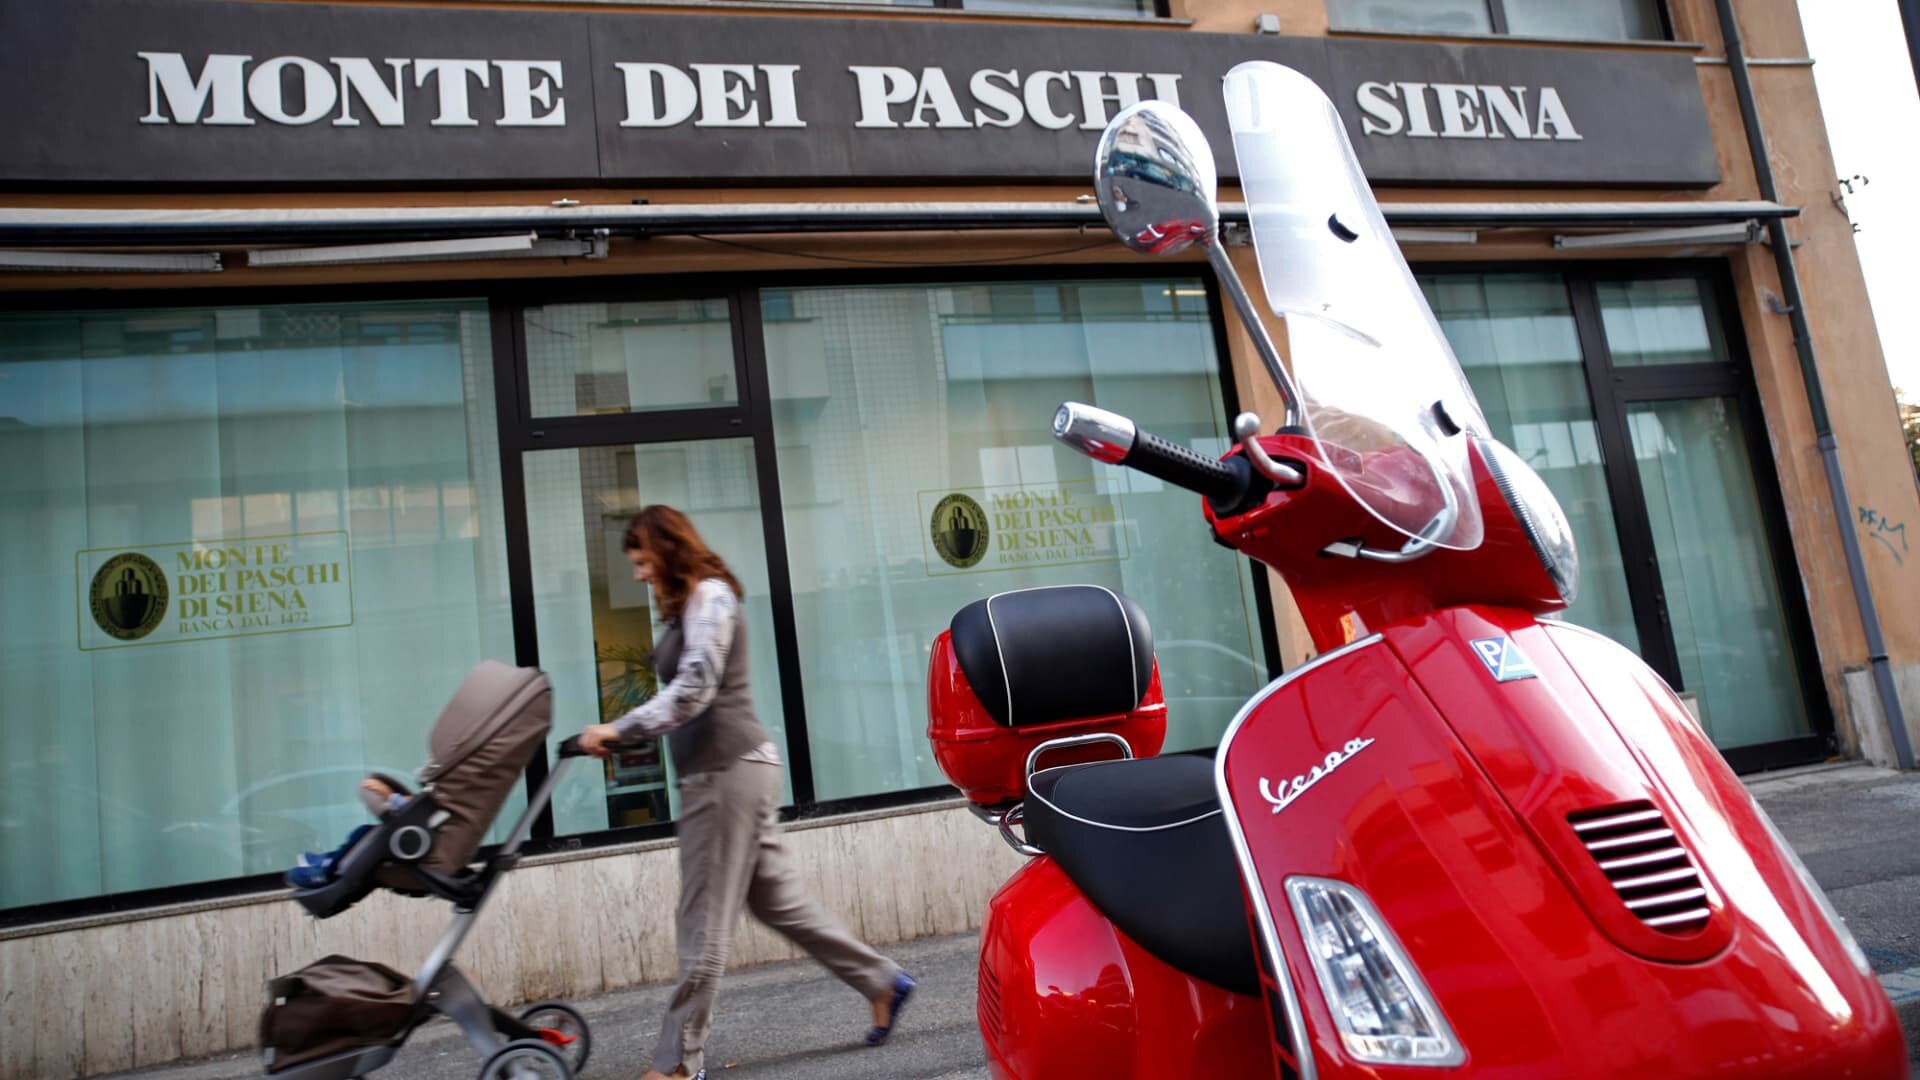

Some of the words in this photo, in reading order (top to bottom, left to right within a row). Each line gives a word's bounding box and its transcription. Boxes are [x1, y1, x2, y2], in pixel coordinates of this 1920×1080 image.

[138, 51, 566, 127] MONTE
[614, 61, 807, 128] DEI
[1356, 80, 1583, 141] SIENA
[992, 488, 1076, 511] MONTE
[994, 510, 1032, 532] DEI
[1039, 503, 1116, 528] PASCHI
[997, 531, 1021, 551] DI
[1024, 527, 1094, 548] SIENA
[176, 543, 289, 572] MONTE
[177, 566, 227, 595] DEI
[236, 562, 340, 591] PASCHI
[178, 597, 208, 619] DI
[215, 589, 307, 617] SIENA
[179, 619, 234, 634] BANCA
[241, 614, 271, 627] DAL
[1259, 737, 1375, 814] Vespa
